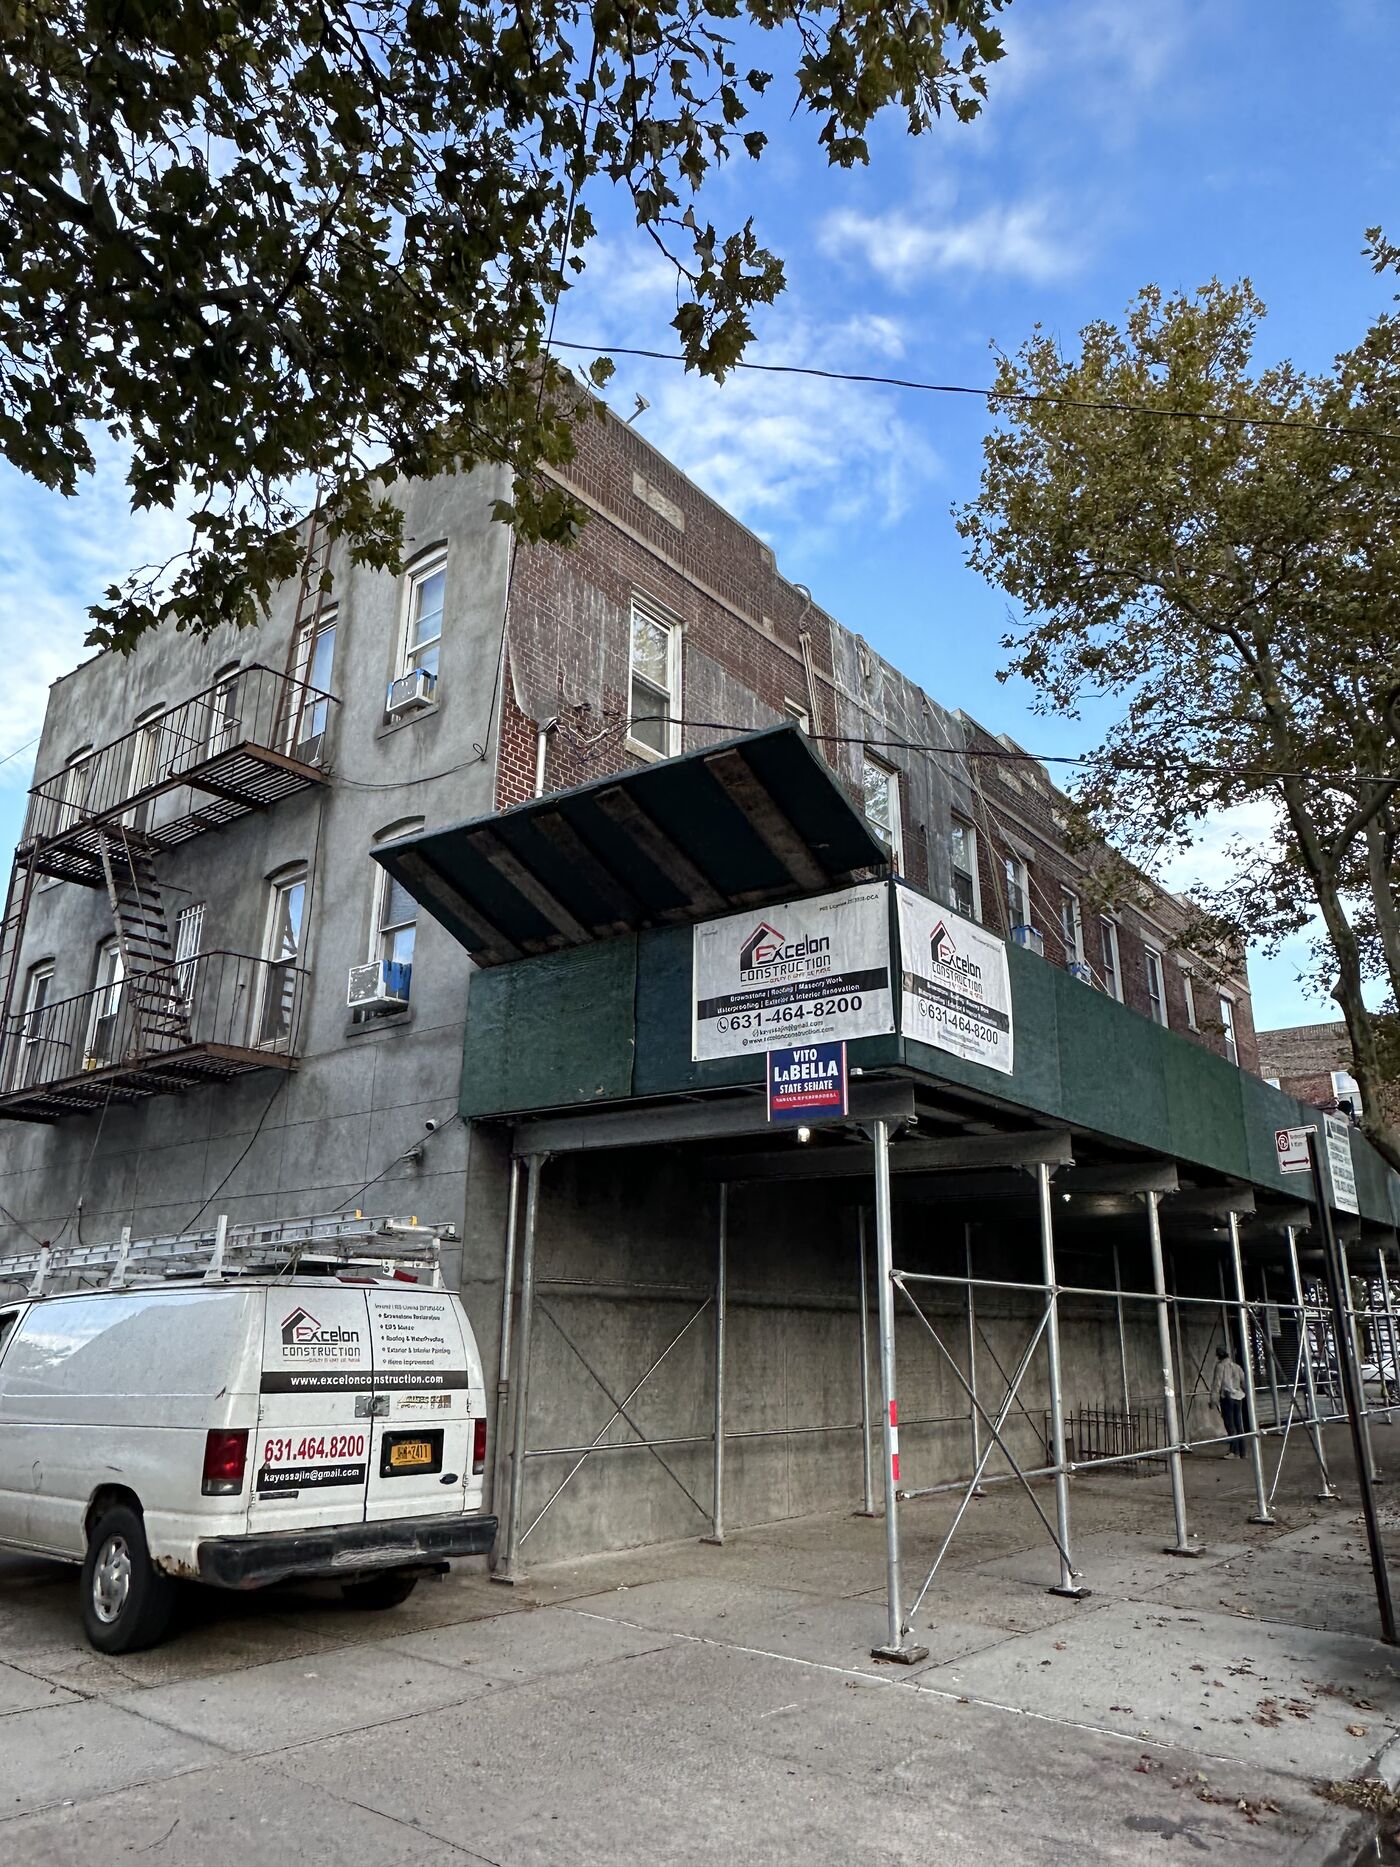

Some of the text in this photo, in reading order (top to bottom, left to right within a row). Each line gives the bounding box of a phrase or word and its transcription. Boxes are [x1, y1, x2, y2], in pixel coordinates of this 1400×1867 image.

[755, 934, 830, 965] Excelon
[940, 944, 981, 979] Excelon
[740, 955, 831, 982] CONSTRUCTION
[932, 962, 983, 994] CONSTRUCTION
[765, 996, 789, 1006] Exterior
[796, 991, 821, 1000] Interior
[822, 984, 860, 996] Renovation
[798, 980, 825, 990] Masonry
[826, 976, 843, 985] Work
[730, 995, 863, 1031] 631-464-8200
[928, 1004, 998, 1045] 631-464-8200
[793, 1048, 818, 1063] VITO
[779, 1079, 833, 1094] STATE SENATE
[296, 1325, 360, 1342] Excelon
[282, 1346, 361, 1357] CONSTRUCTION
[290, 1374, 444, 1386] www.excelonconstruction.com
[264, 1435, 364, 1462] 631.464.8200
